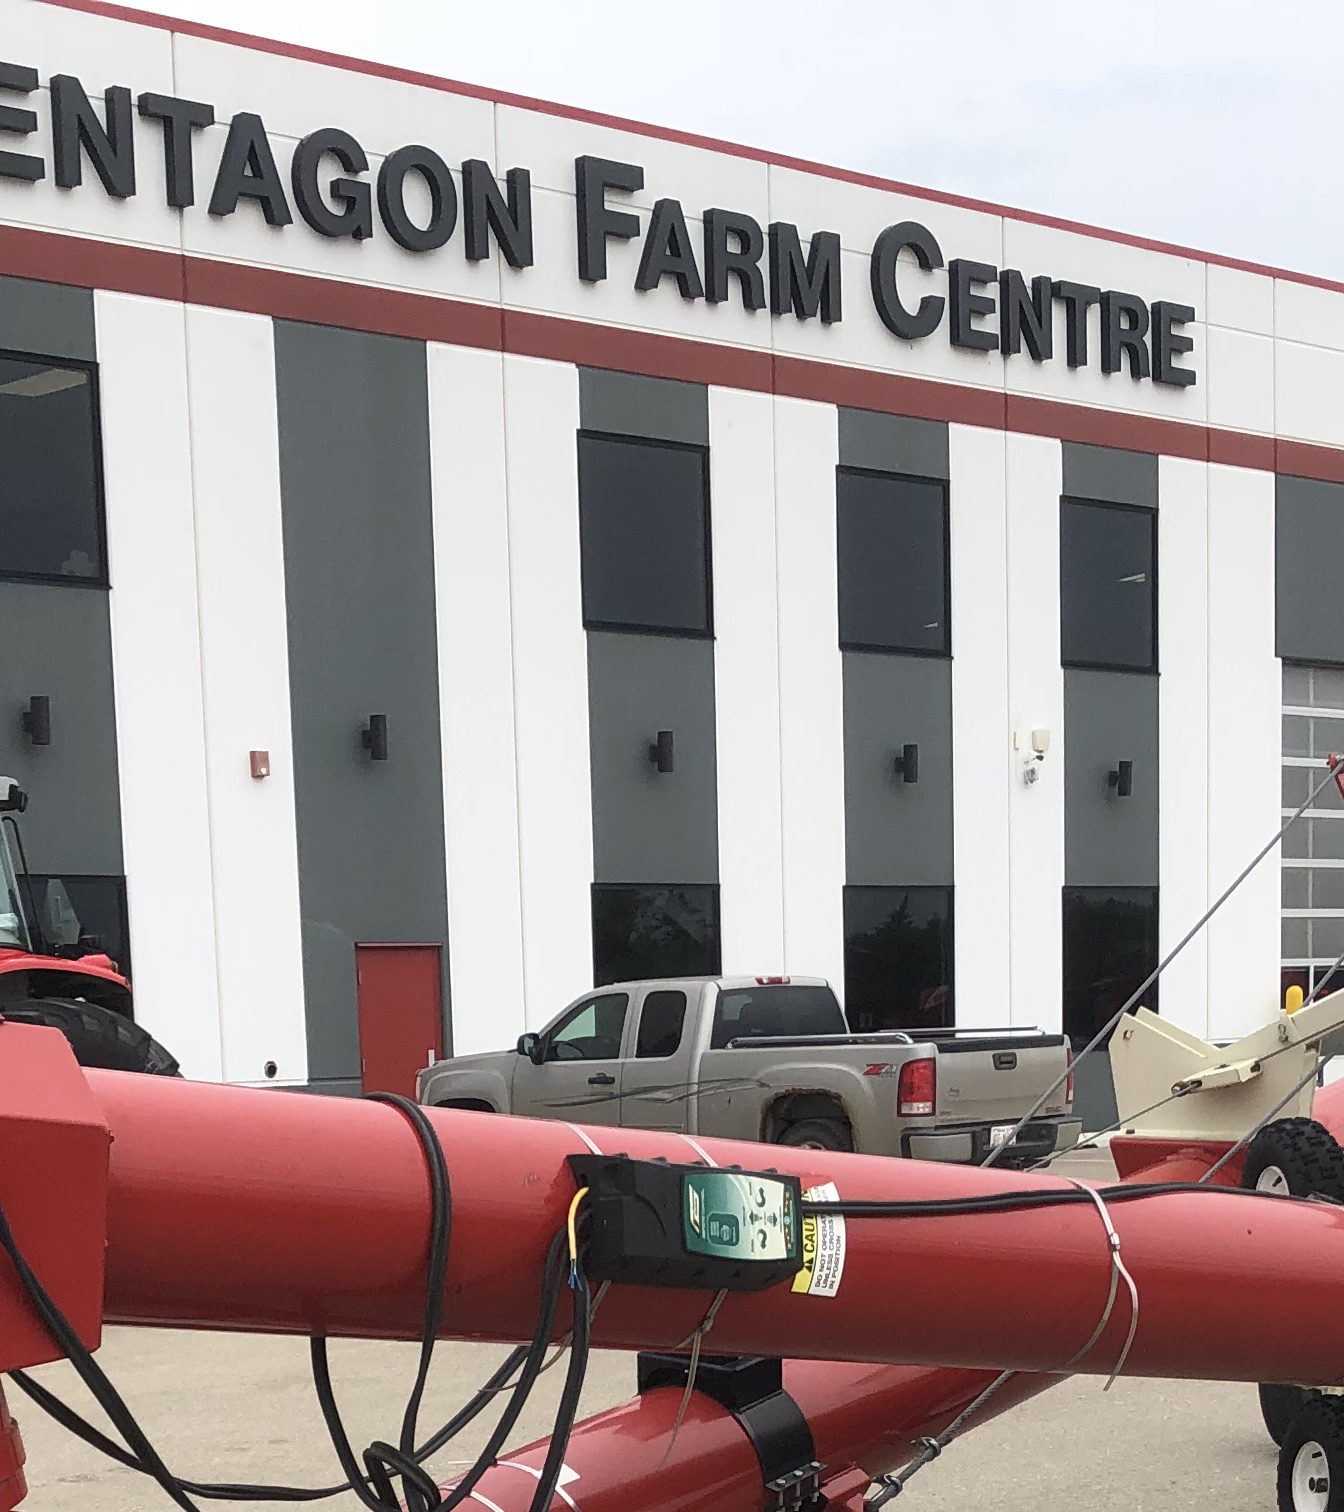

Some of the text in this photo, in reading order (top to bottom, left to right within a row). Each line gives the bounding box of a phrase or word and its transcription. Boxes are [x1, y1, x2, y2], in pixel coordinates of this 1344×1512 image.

[575, 155, 842, 323] FARM
[870, 221, 1196, 388] CENTRE
[818, 1253, 827, 1272] NOT
[821, 1253, 834, 1288] UNLESS
[828, 1234, 842, 1289] IN POSITION
[815, 1274, 823, 1287] DO
